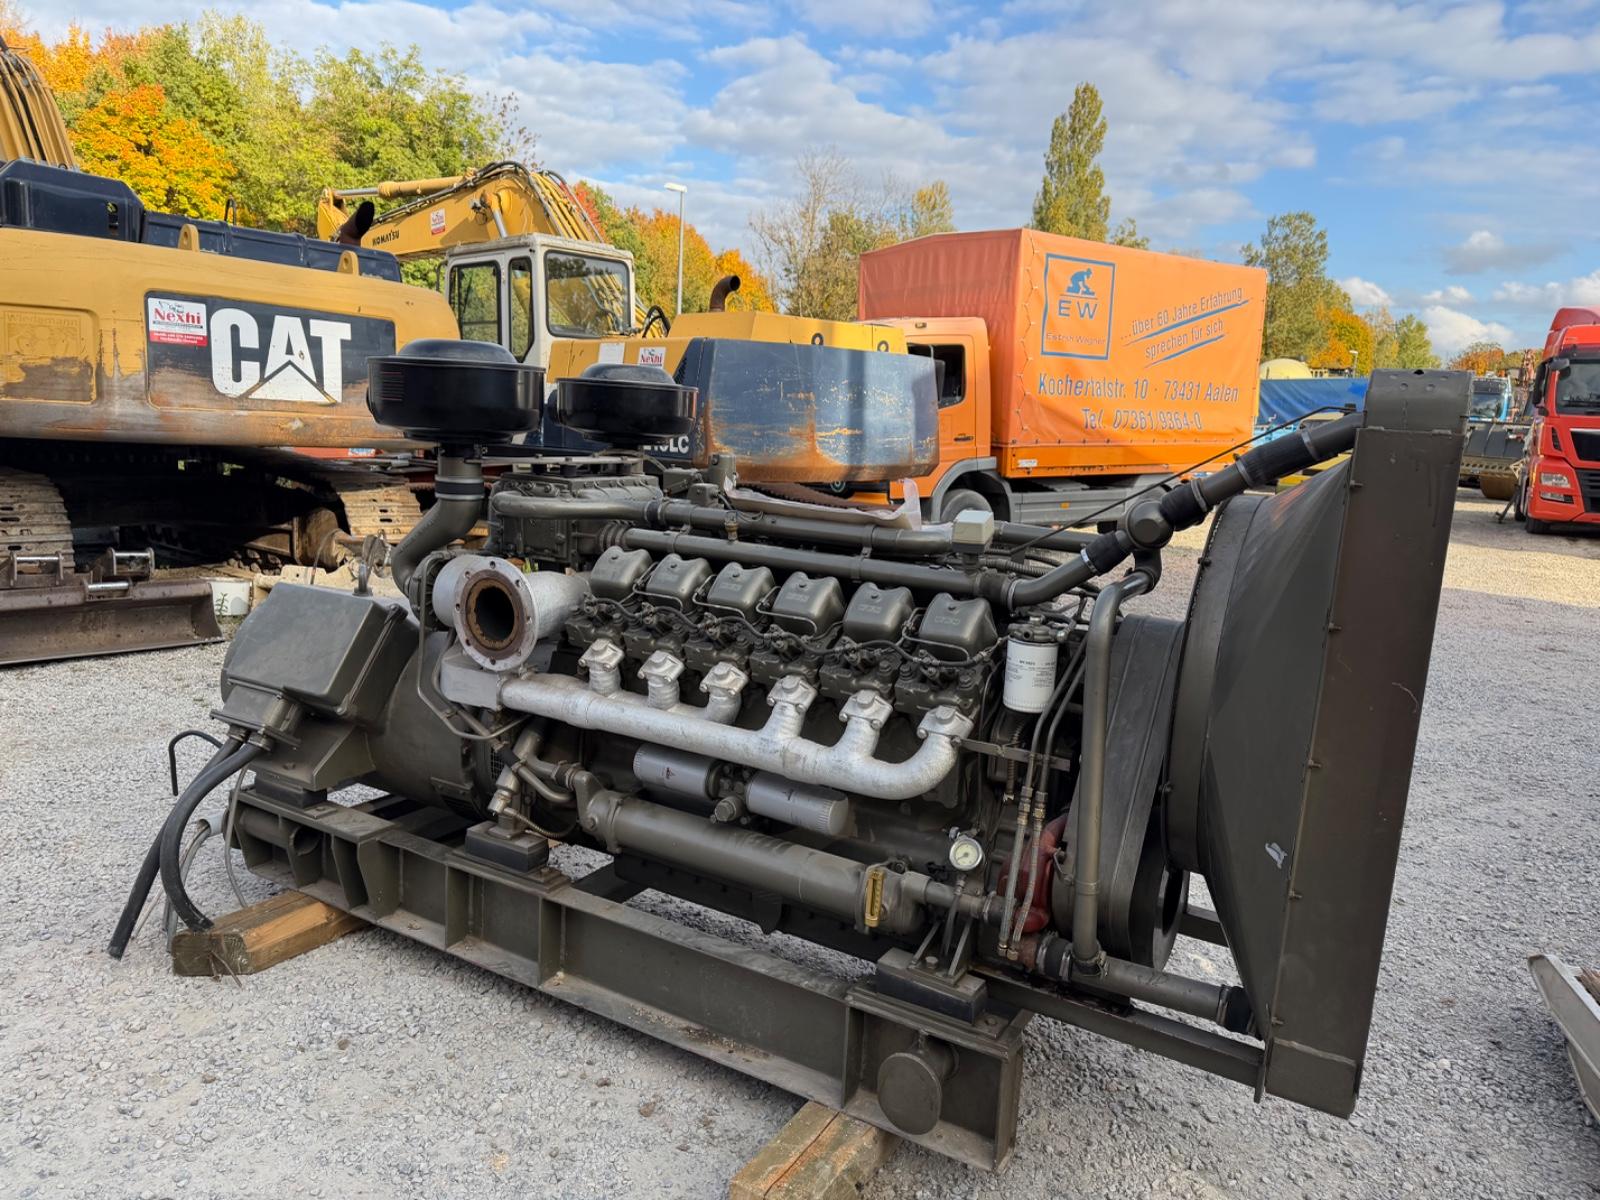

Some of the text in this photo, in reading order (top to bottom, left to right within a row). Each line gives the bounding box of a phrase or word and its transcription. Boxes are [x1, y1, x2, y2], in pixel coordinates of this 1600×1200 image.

[372, 229, 400, 246] KOMATSU
[154, 307, 202, 325] Nexhi
[1172, 302, 1198, 322] Jahre
[1200, 287, 1242, 312] Erfahrung
[1145, 317, 1224, 360] sprechen für sich
[210, 308, 352, 404] CAT
[1037, 372, 1239, 402] Kochertalstr. 10 73431 Aalen
[1082, 407, 1105, 430] Tel.
